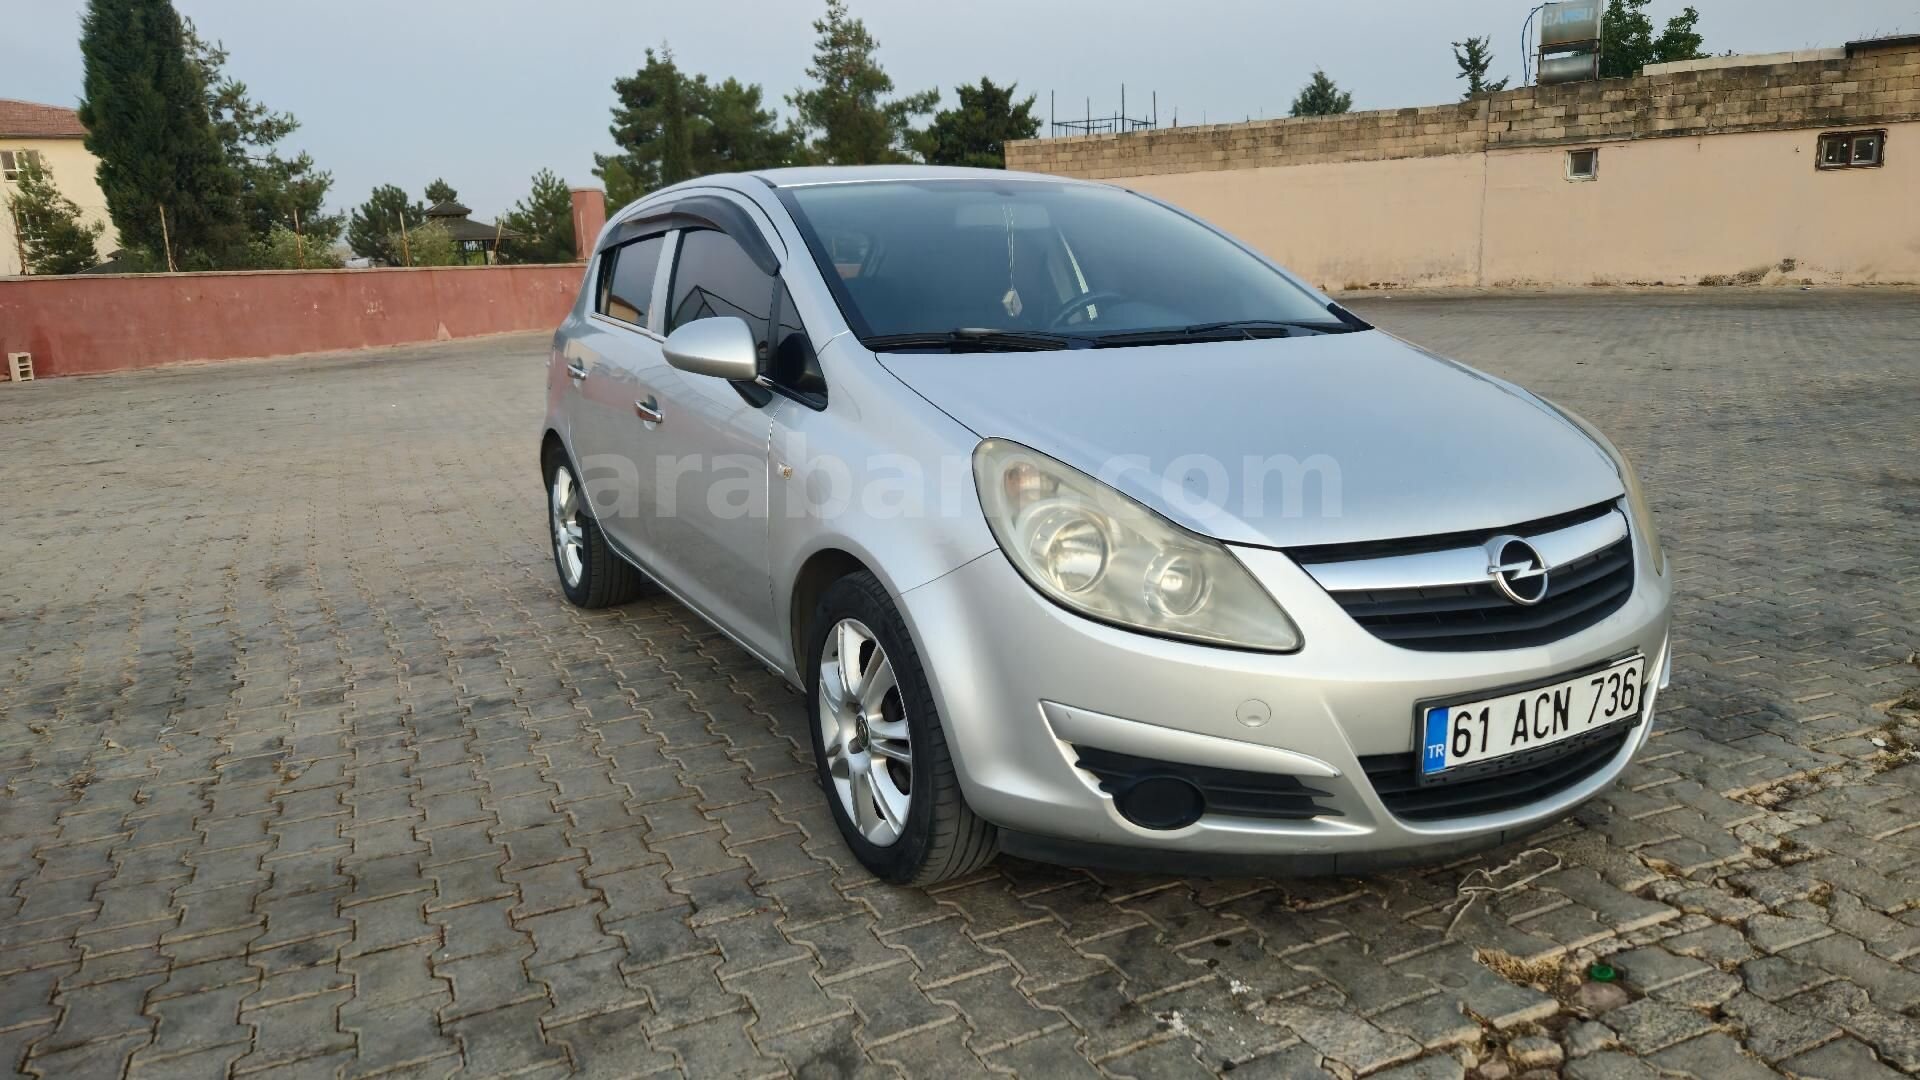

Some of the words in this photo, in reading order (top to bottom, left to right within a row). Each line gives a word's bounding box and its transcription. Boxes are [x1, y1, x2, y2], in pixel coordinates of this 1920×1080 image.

[1452, 707, 1490, 758] 61
[1510, 686, 1572, 746] ACN
[1587, 667, 1637, 724] 736
[1428, 744, 1445, 759] TR
